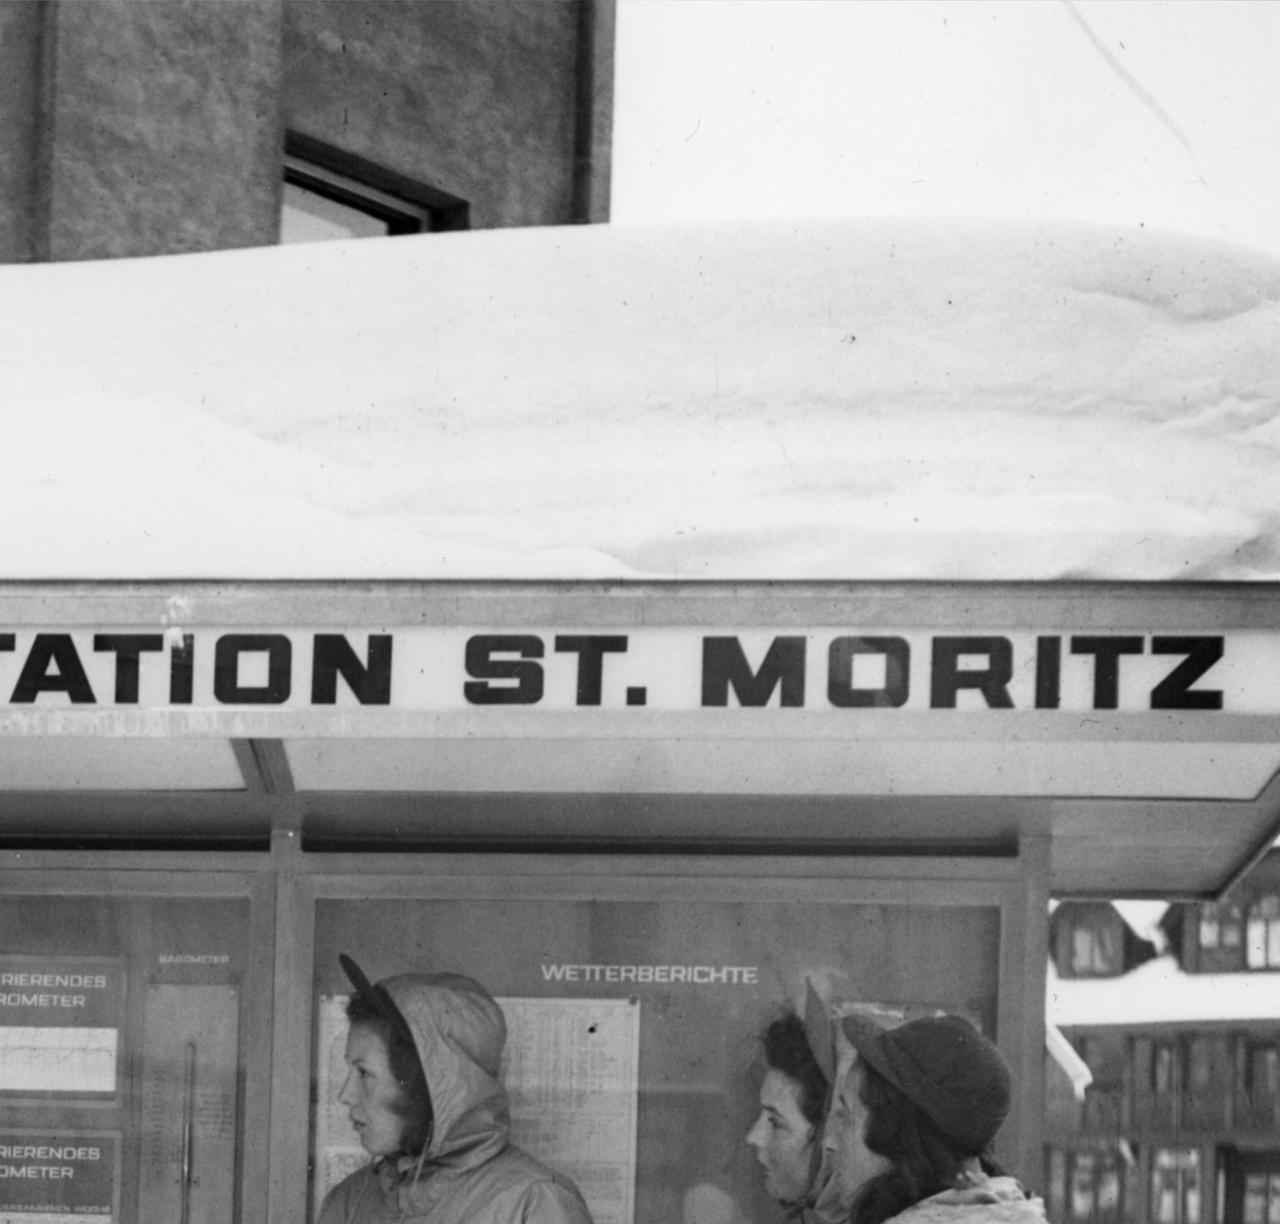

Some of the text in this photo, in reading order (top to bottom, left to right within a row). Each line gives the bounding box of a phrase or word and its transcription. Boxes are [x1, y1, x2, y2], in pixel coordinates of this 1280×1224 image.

[464, 635, 646, 705] ST.
[702, 636, 1224, 710] MORITZ
[541, 964, 758, 984] WETTERBERICHTE
